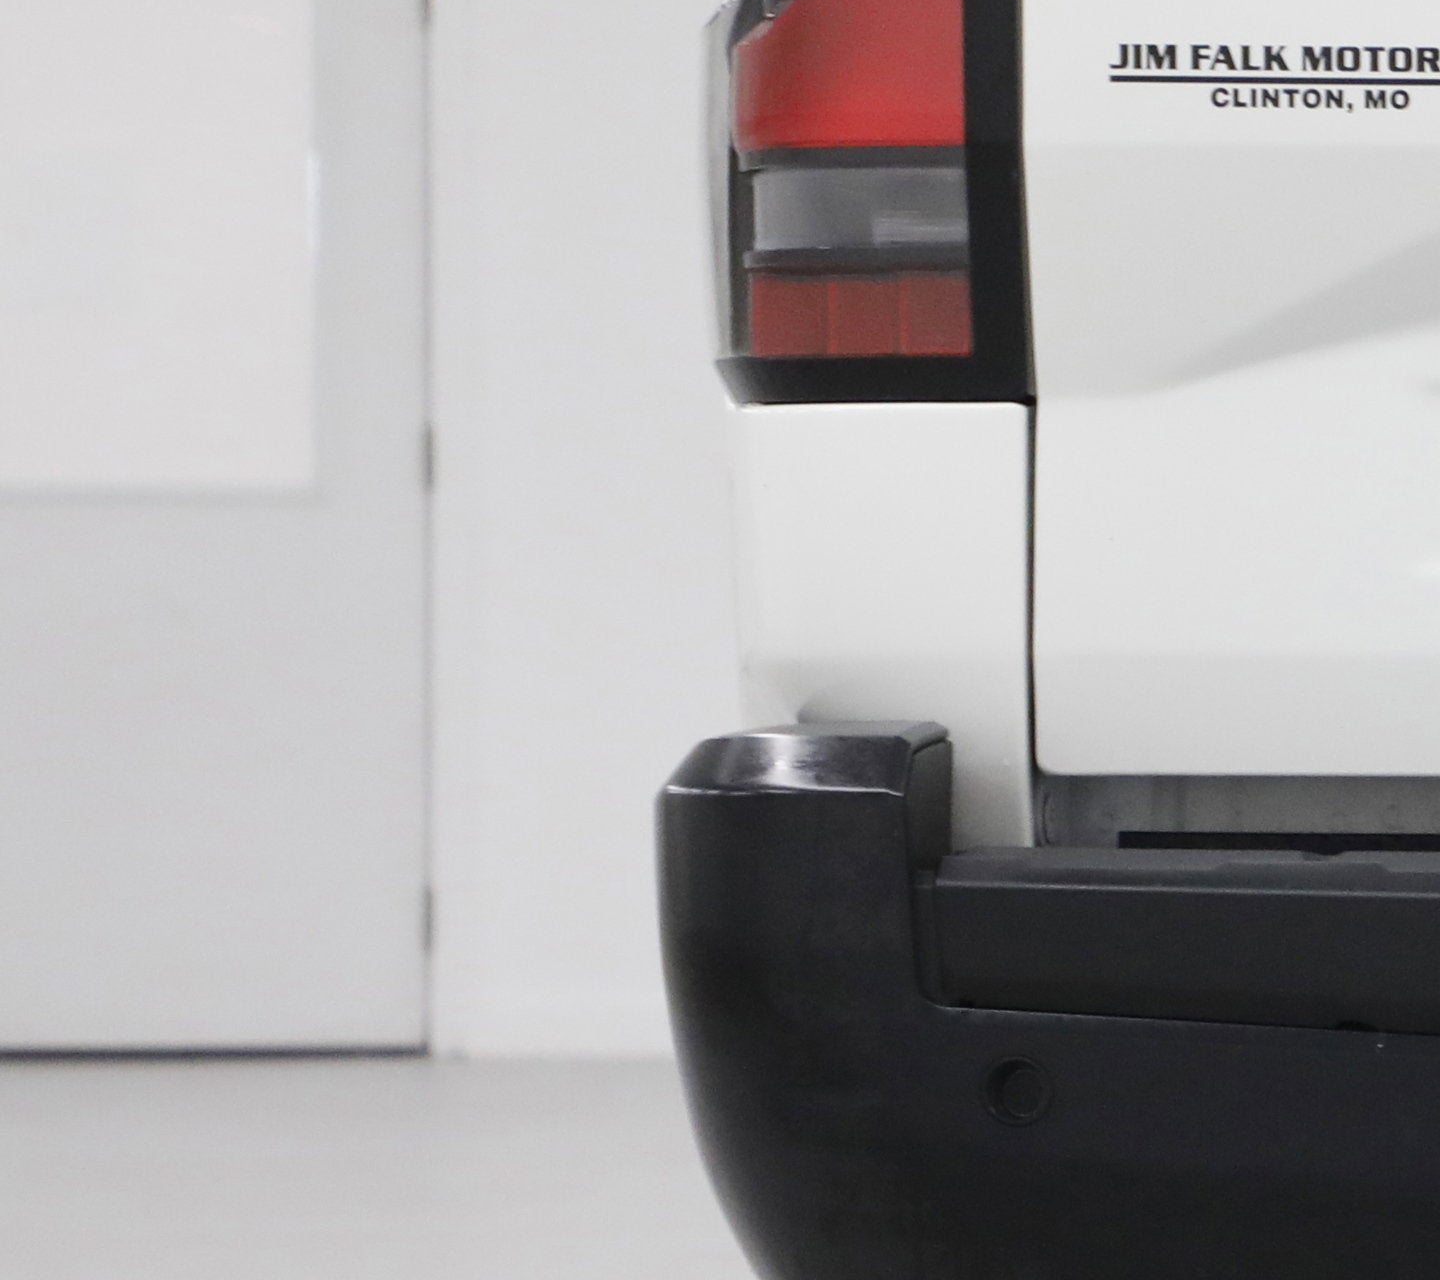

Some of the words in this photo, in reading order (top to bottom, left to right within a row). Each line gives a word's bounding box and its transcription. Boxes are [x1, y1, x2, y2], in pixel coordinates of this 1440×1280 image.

[1109, 42, 1177, 70] JIM
[1190, 43, 1289, 72] FALK
[1210, 87, 1354, 113] CLINTON,
[1363, 89, 1411, 110] MO
